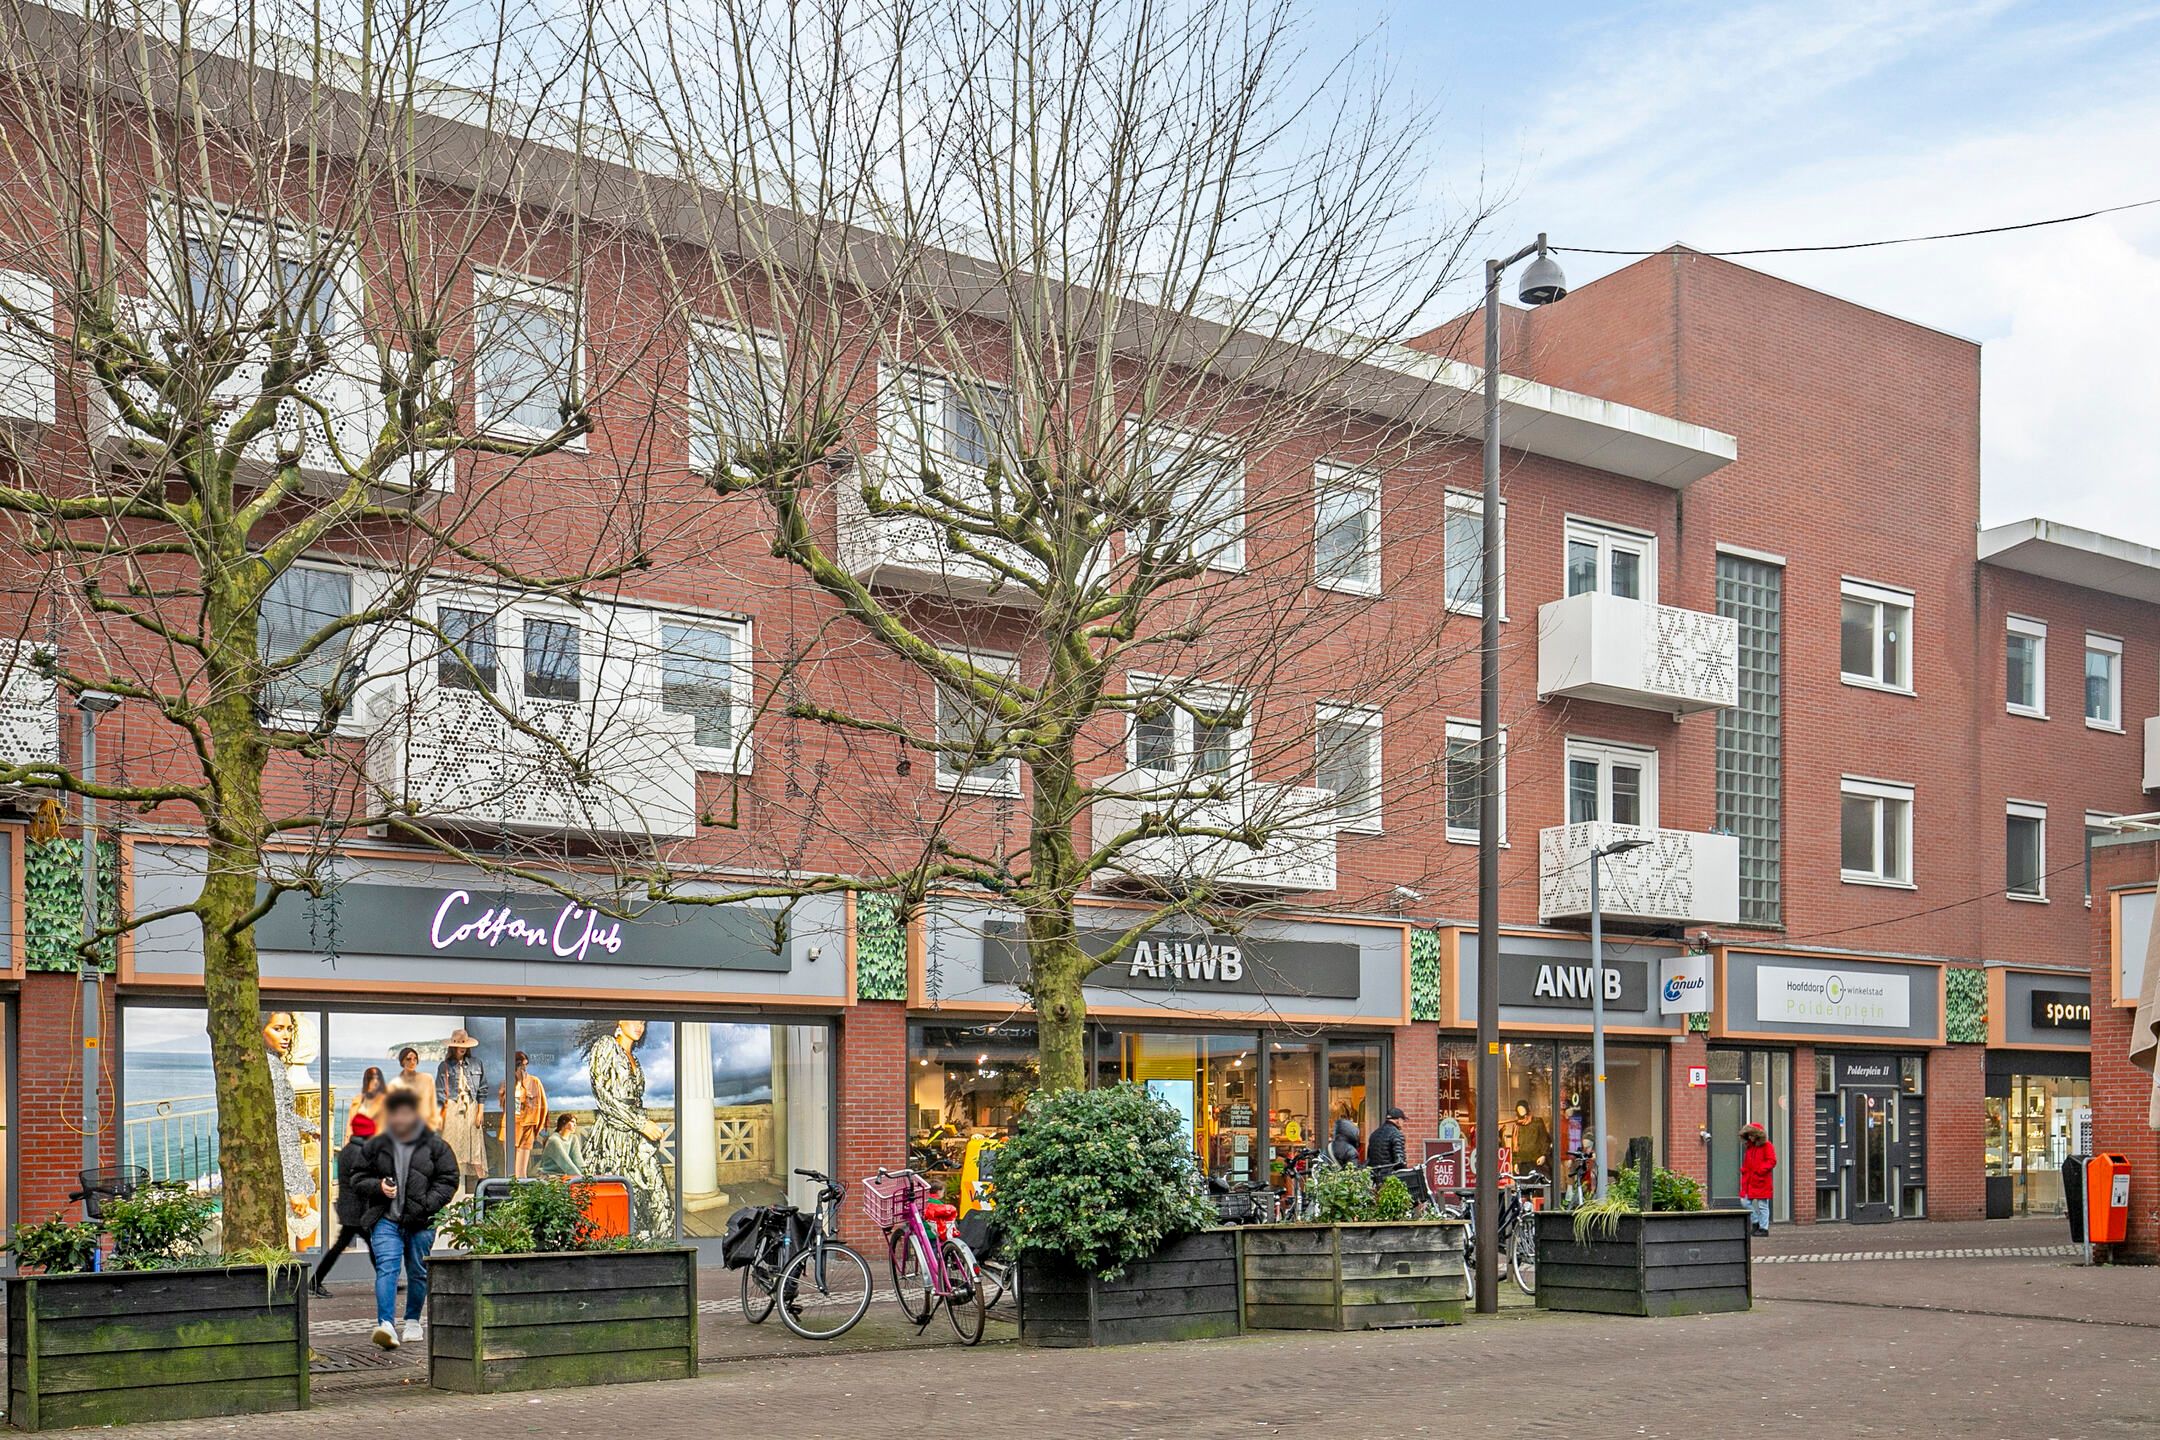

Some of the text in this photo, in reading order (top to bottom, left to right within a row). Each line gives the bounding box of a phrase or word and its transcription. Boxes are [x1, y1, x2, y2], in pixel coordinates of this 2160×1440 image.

[431, 890, 622, 961] Cotton Club
[1129, 940, 1243, 981] ANWB
[1534, 964, 1622, 1000] ANWB
[1672, 977, 1704, 990] anwb
[1786, 981, 1884, 996] Hoofddorp winkelstad
[1786, 1000, 1884, 1019] Polderplein
[1695, 1072, 1700, 1081] B
[1847, 1065, 1881, 1077] Polderplein
[1439, 1089, 1460, 1100] SALE
[1434, 1165, 1453, 1174] SALE
